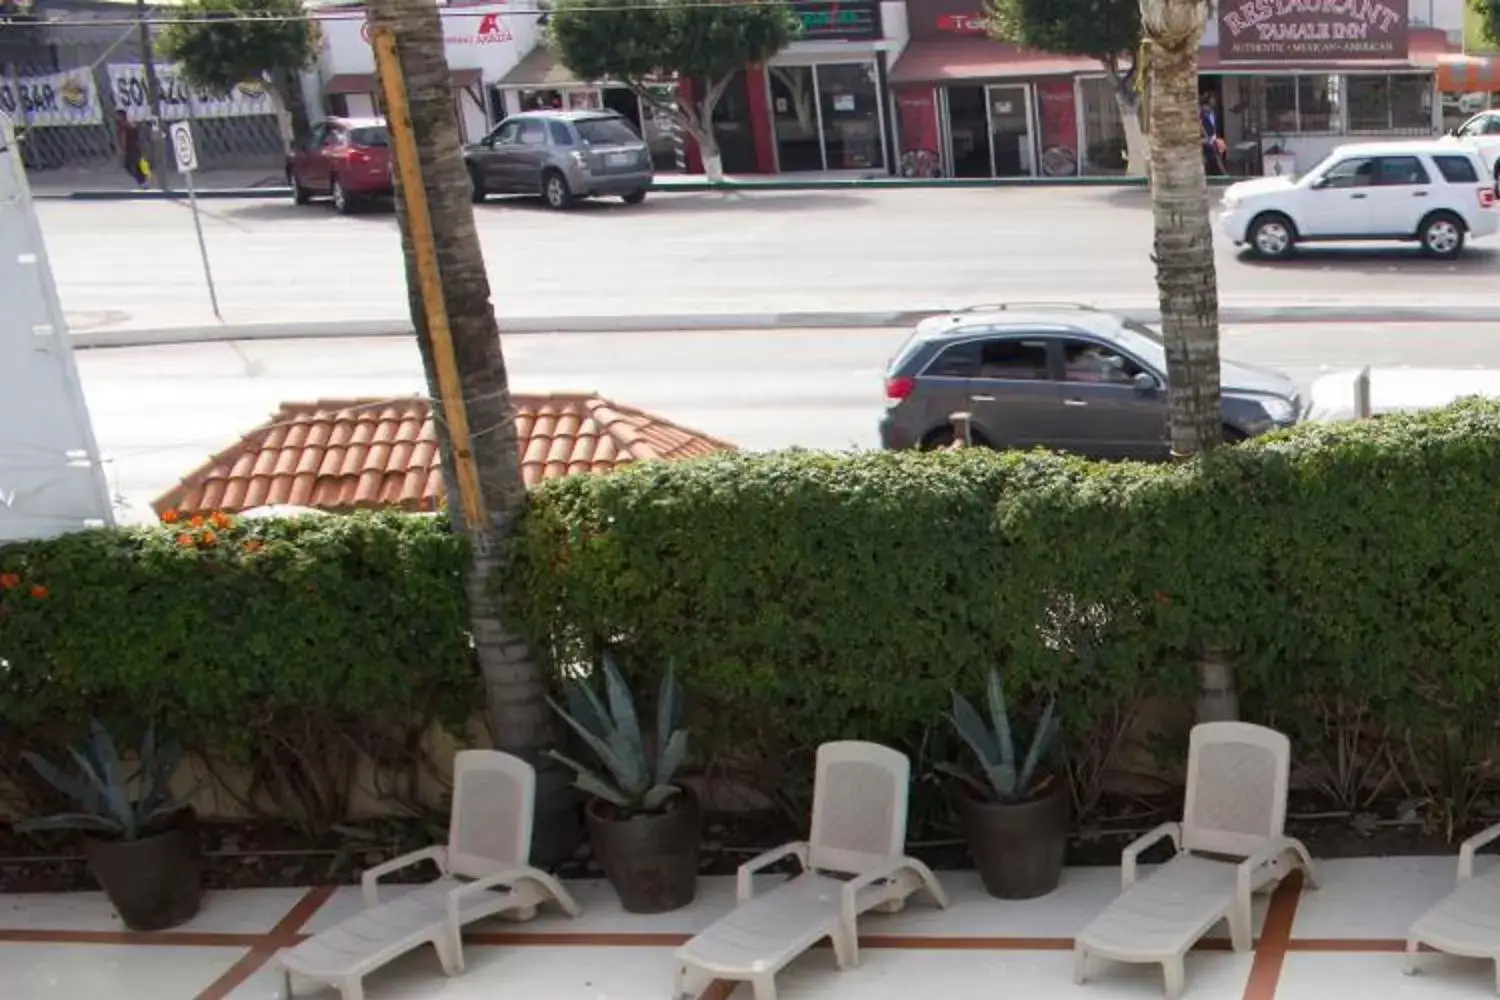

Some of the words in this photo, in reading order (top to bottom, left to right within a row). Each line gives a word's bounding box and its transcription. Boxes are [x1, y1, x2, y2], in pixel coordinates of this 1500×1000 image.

[1256, 22, 1329, 40] TAMALE
[1332, 22, 1367, 39] INN
[20, 83, 58, 112] BAR
